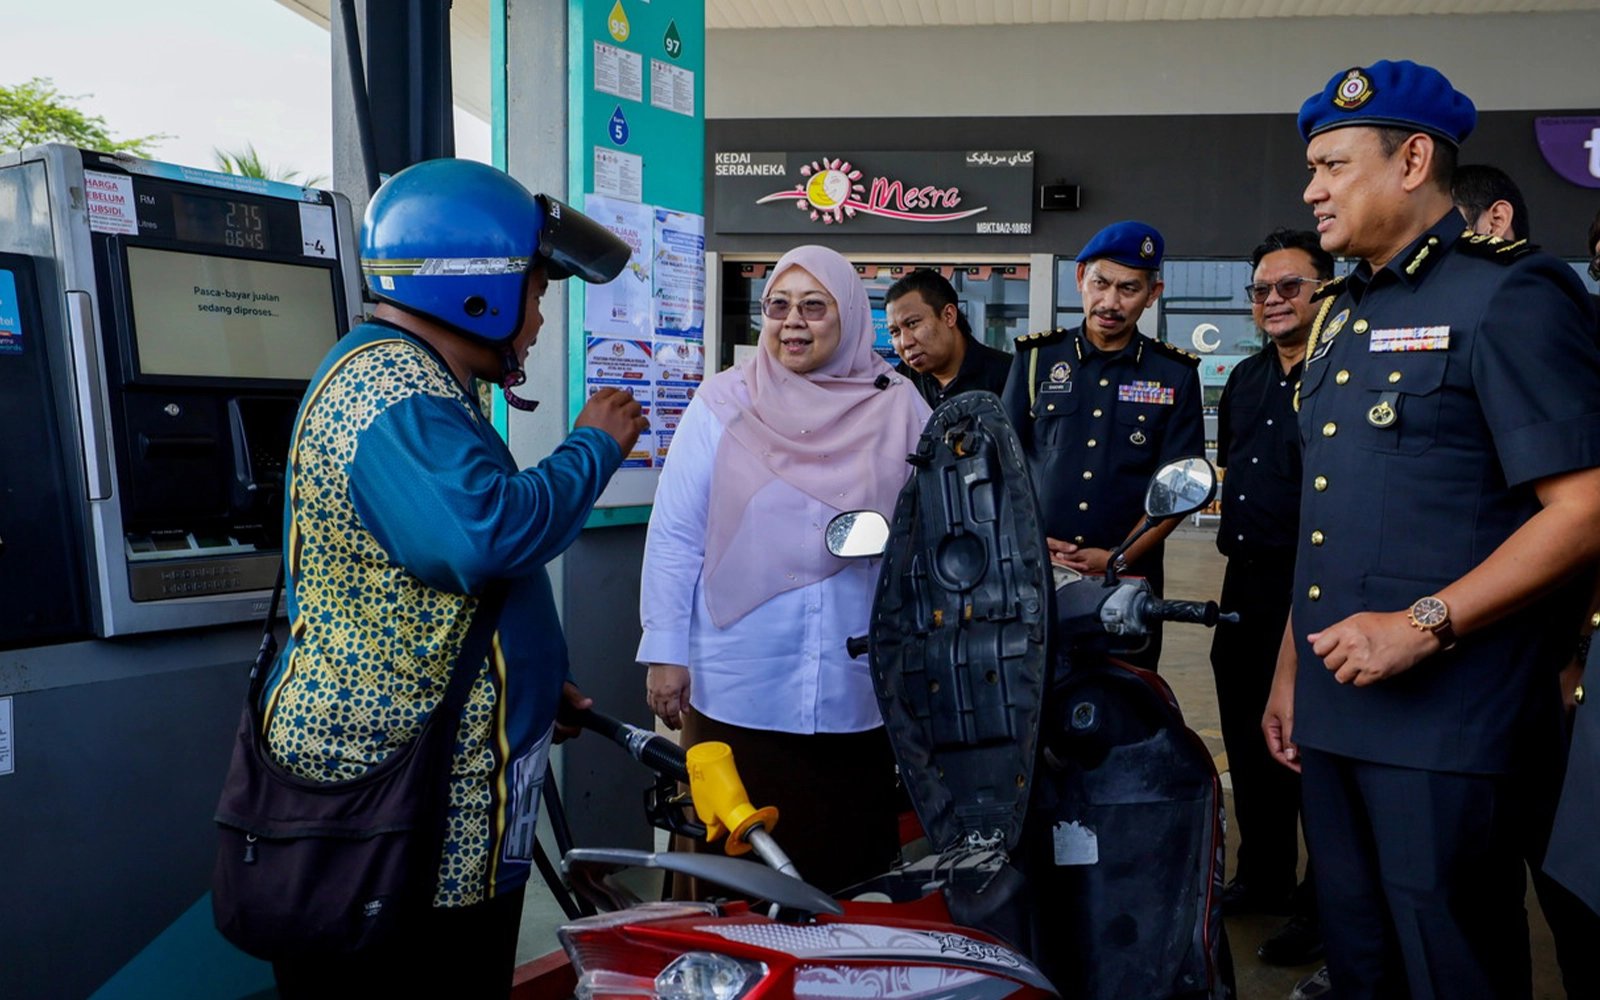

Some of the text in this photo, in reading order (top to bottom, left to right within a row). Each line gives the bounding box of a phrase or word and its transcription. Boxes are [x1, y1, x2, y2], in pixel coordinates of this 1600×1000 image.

[611, 20, 627, 35] 95
[665, 38, 680, 54] 97
[615, 125, 623, 139] 5
[715, 152, 751, 164] KEDAI
[715, 164, 786, 176] SERBANEKA
[84, 178, 119, 191] HARGA
[140, 194, 156, 205] RM
[869, 176, 962, 212] Mesra
[226, 202, 262, 231] 2.75
[193, 285, 280, 302] Pasca-bayar jualan
[197, 303, 232, 315] sedang
